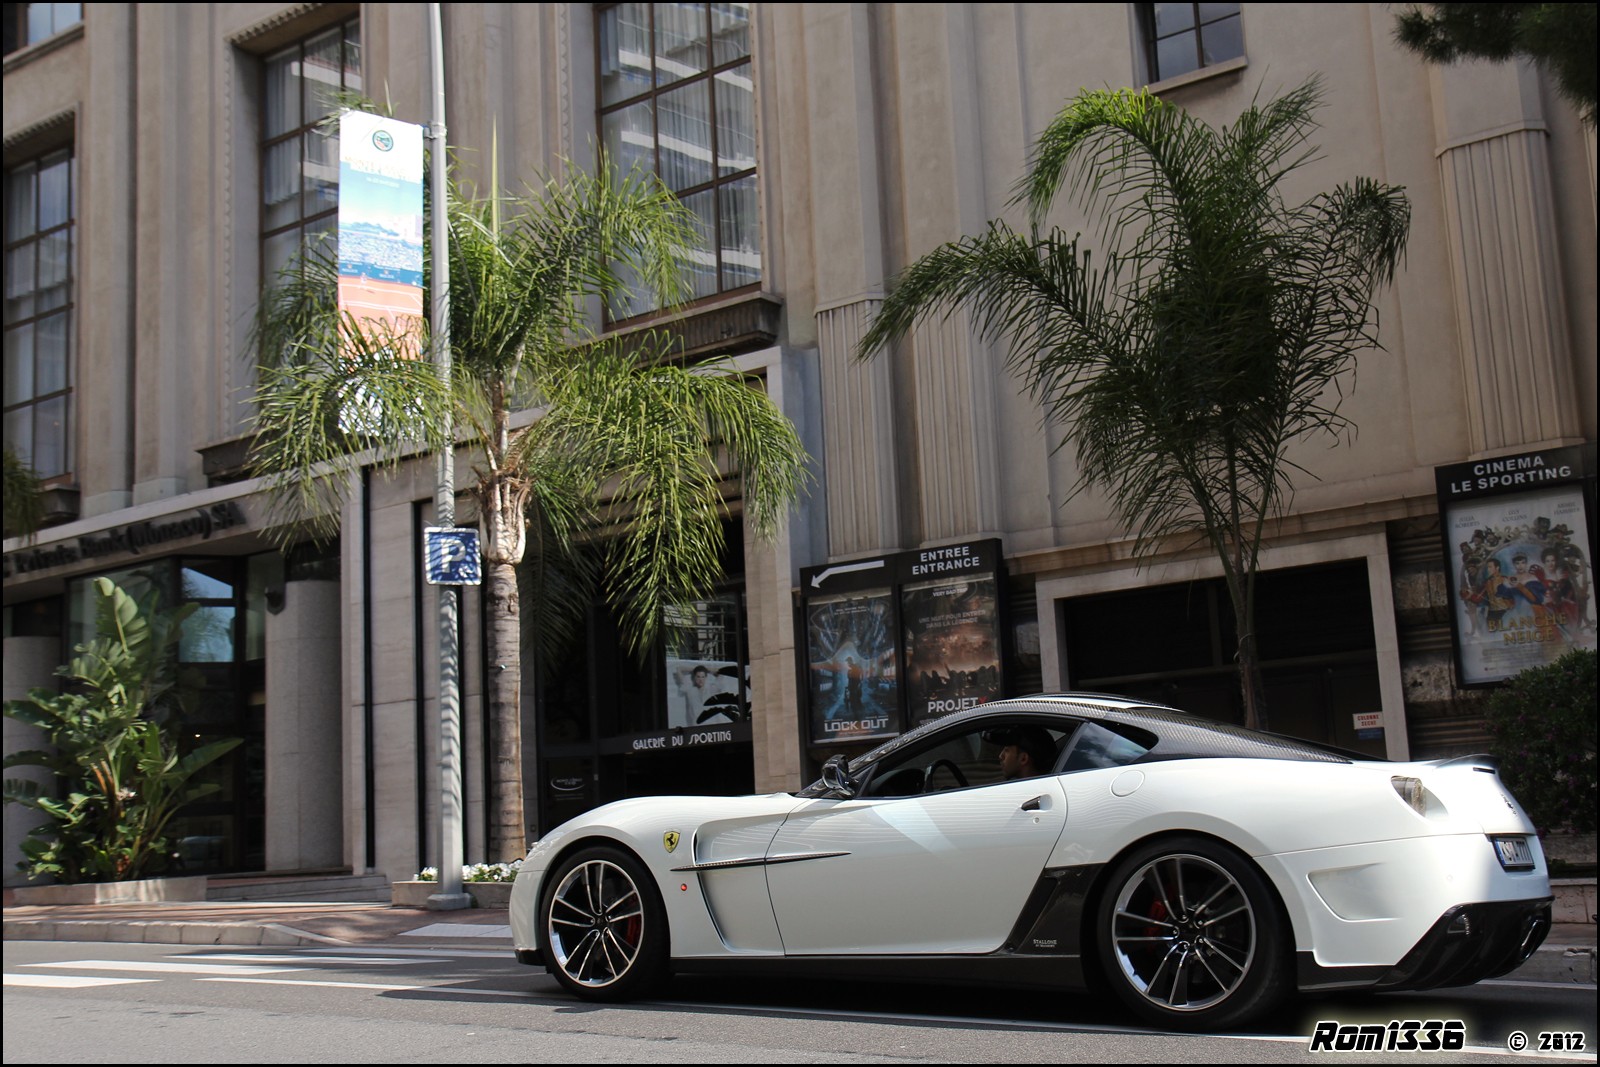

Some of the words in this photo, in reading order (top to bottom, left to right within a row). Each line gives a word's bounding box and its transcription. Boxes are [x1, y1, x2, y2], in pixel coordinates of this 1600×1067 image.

[1473, 455, 1545, 476] CINEMA
[1451, 480, 1472, 494] LE
[1477, 465, 1572, 490] SPORTING
[440, 538, 466, 573] P
[920, 546, 970, 562] ENTREE
[912, 556, 980, 575] ENTRANCE
[1487, 612, 1567, 632] BLANCHE
[1503, 628, 1555, 645] NEIGE
[927, 697, 978, 713] PROJET
[824, 721, 859, 732] LOCK
[861, 718, 889, 730] OUT
[632, 737, 666, 750] GALERIE
[671, 735, 684, 747] DU
[688, 731, 732, 745] SPORTING
